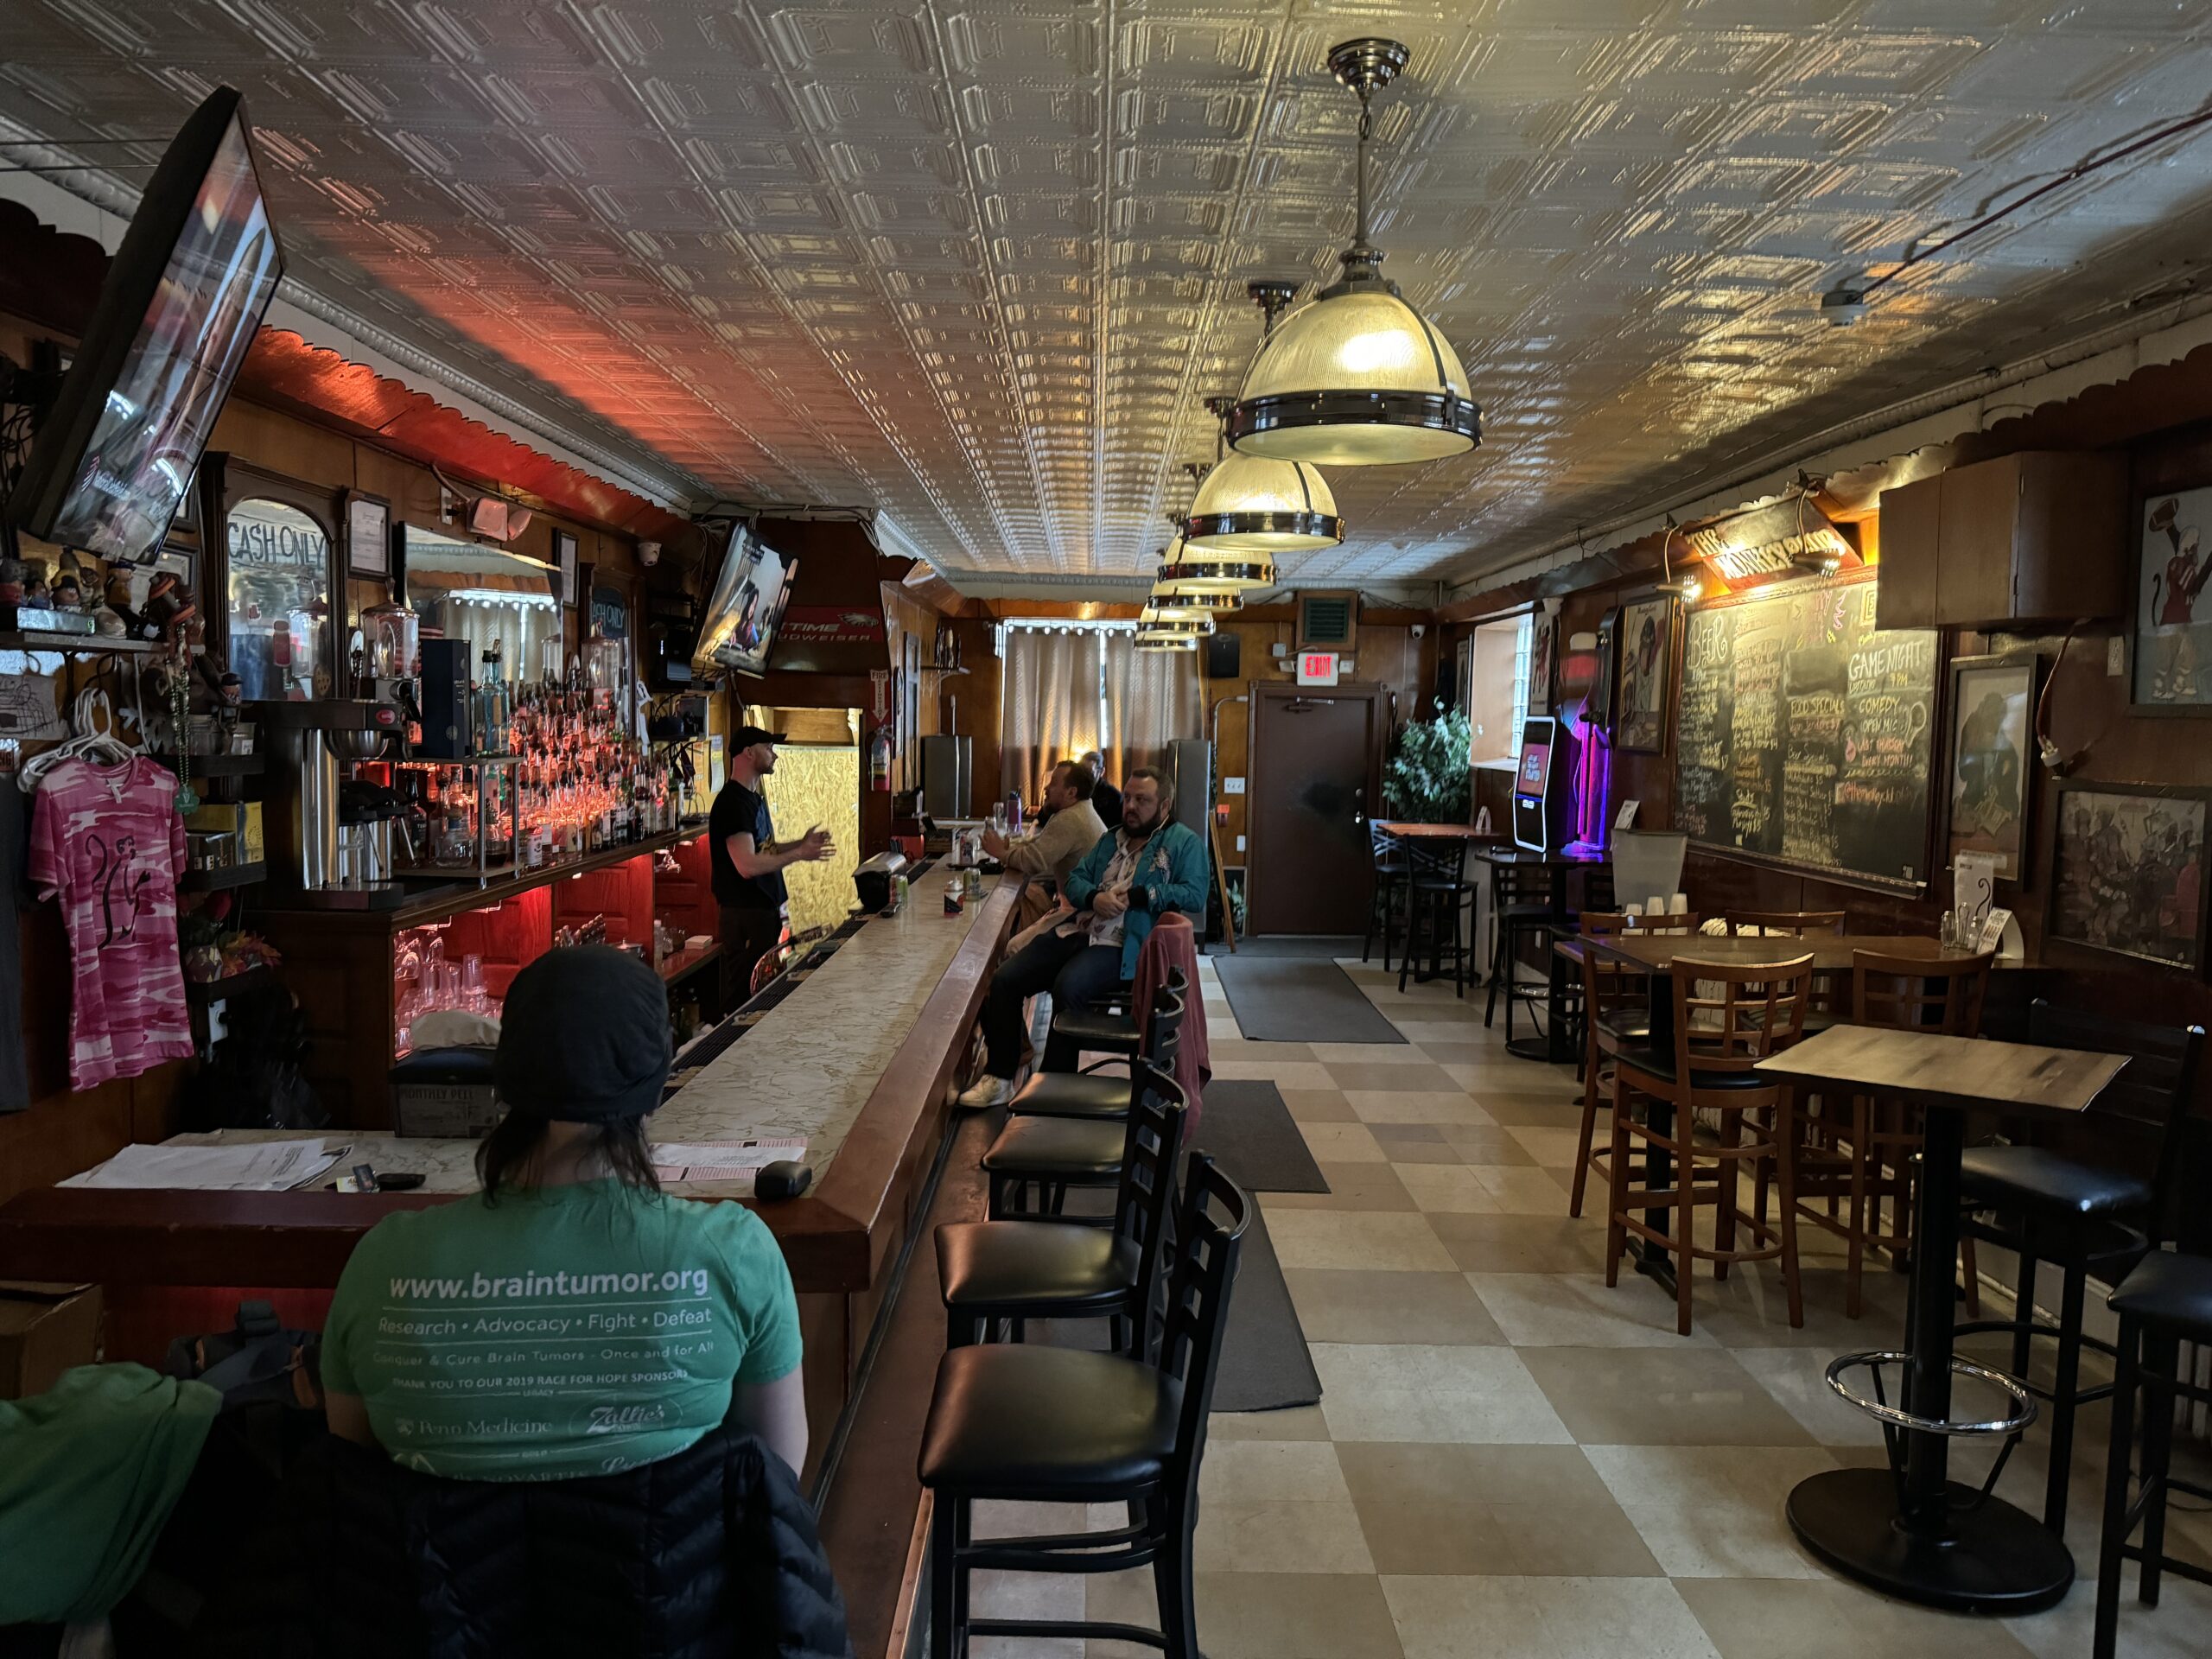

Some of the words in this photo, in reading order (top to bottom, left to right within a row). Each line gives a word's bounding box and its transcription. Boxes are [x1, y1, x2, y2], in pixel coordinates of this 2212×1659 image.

[228, 522, 276, 564] CASH
[280, 525, 327, 570] ONLY
[778, 633, 871, 642] UDWEISER
[1687, 615, 1727, 670] BEER
[1306, 655, 1332, 678] EXIT
[1849, 648, 1886, 682] GAME
[1886, 639, 1924, 674] NIGHT
[1859, 696, 1901, 715] COMEDY
[1883, 717, 1898, 734] MIC
[1857, 739, 1874, 753] LAST
[390, 1268, 709, 1297] www.braintumor.org
[378, 1317, 456, 1335] Research
[474, 1316, 572, 1335] Advocacy
[588, 1313, 637, 1332] Fight
[653, 1308, 713, 1328] Defeat
[446, 1352, 481, 1366] Cure
[487, 1351, 526, 1364] Brain
[532, 1349, 586, 1363] Tumors
[601, 1348, 639, 1361] Once
[644, 1345, 671, 1360] and
[674, 1344, 693, 1357] for
[697, 1340, 715, 1355] All
[429, 1378, 454, 1391] YOU
[458, 1378, 474, 1389] TO
[476, 1377, 503, 1389] OUR
[505, 1376, 535, 1388] 2019
[537, 1374, 568, 1387] RACE
[570, 1372, 594, 1385] FOR
[596, 1371, 626, 1384] HOPE
[467, 1415, 553, 1435] Medicine
